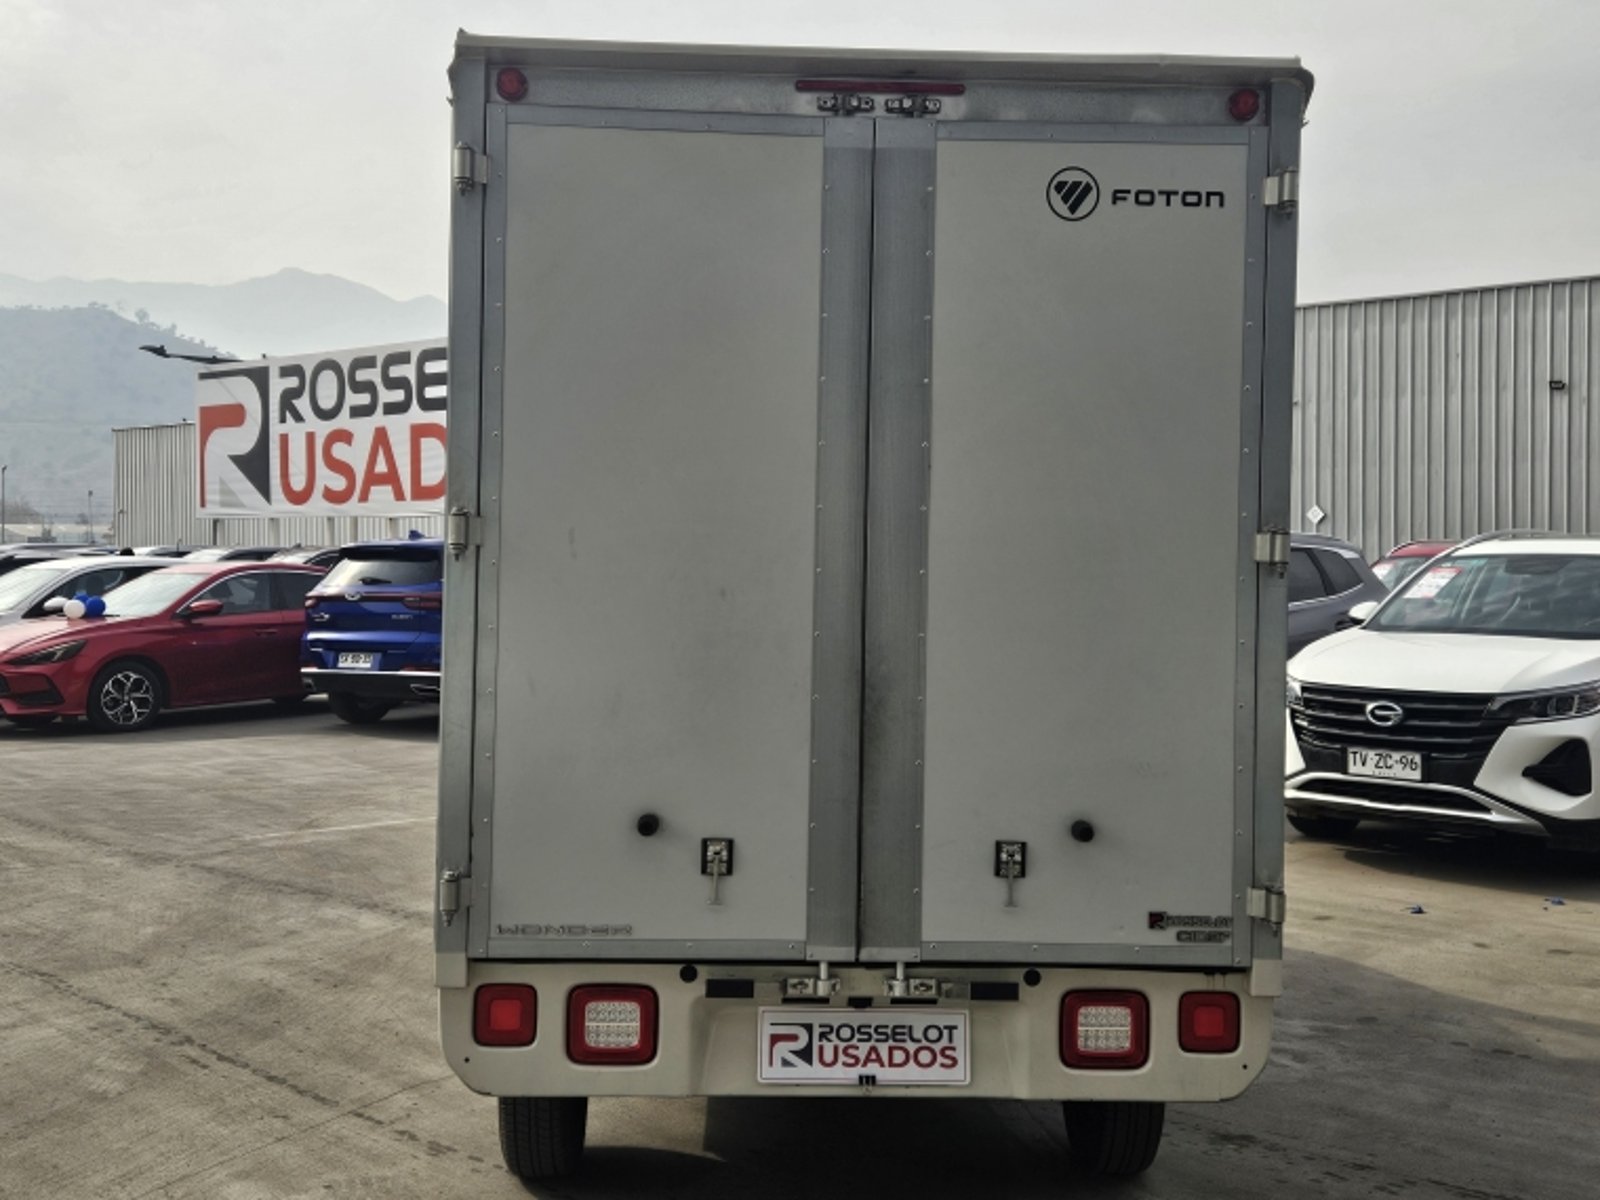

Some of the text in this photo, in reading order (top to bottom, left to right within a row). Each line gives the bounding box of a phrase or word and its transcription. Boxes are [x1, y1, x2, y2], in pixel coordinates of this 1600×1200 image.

[1111, 189, 1225, 208] FOTON
[818, 1023, 958, 1044] ROSSELOT
[818, 1045, 959, 1069] USADOS
